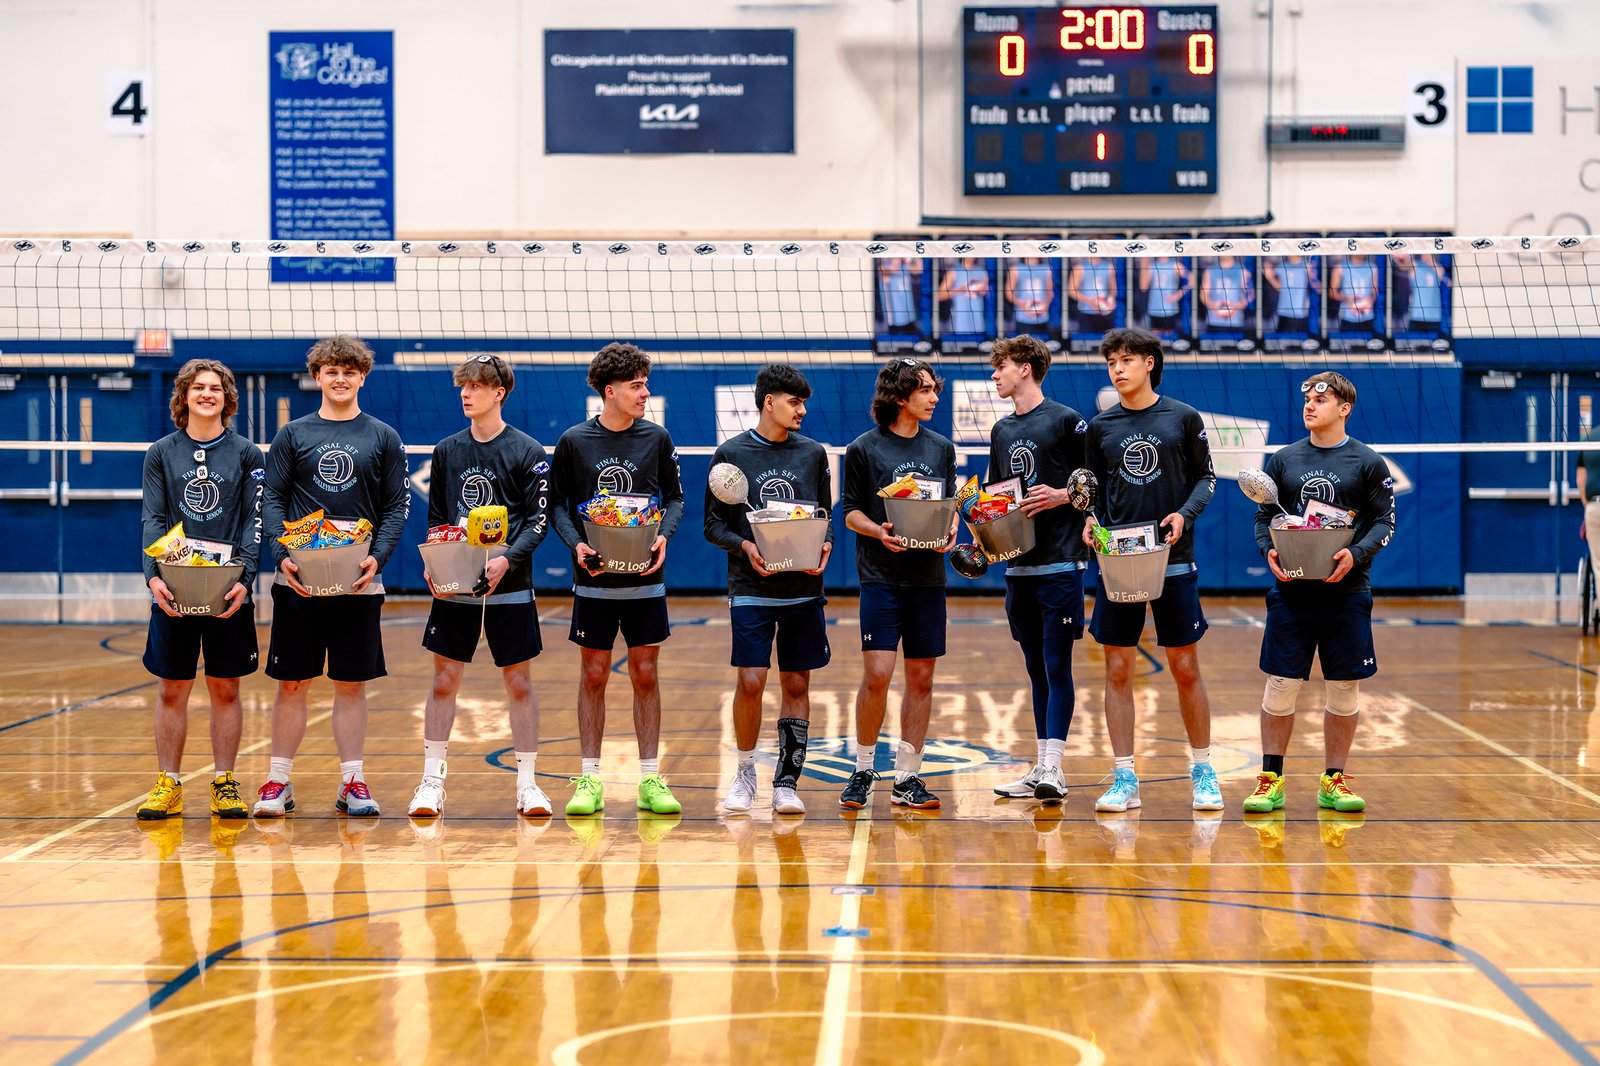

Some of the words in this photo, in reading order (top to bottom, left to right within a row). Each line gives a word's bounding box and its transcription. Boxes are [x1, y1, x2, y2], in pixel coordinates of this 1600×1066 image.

[974, 12, 1018, 32] Home
[1158, 10, 1212, 31] Guests
[1060, 9, 1145, 50] 2:00
[616, 55, 635, 66] and
[636, 55, 689, 66] Northwest
[691, 55, 728, 66] Indiana
[730, 55, 748, 66] Kia
[749, 55, 788, 66] Dealers
[999, 35, 1025, 76] 0
[1188, 33, 1214, 75] 0
[628, 71, 658, 82] Proud
[660, 72, 671, 82] to
[672, 72, 711, 84] support
[1066, 74, 1115, 97] period
[595, 84, 645, 96] Plainfield
[647, 84, 677, 96] South
[679, 84, 706, 97] High
[707, 84, 744, 96] School
[111, 80, 148, 125] 4
[1413, 81, 1448, 126] 3
[971, 106, 1008, 125] fouls
[1064, 103, 1116, 125] player
[1172, 104, 1210, 123] fouls
[974, 172, 1006, 188] won
[1070, 171, 1110, 190] game
[1176, 171, 1208, 187] won
[316, 442, 341, 454] FINAL
[343, 443, 359, 456] SET
[1008, 439, 1024, 455] FINAL
[1025, 439, 1038, 451] SET
[1120, 433, 1144, 449] FINAL
[1146, 434, 1162, 446] SET
[595, 456, 620, 470] FINAL
[623, 459, 639, 473] SET
[919, 462, 934, 475] SET
[209, 471, 225, 484] SET
[459, 466, 481, 481] FINAL
[483, 468, 497, 481] SET
[755, 468, 778, 485] FINAL
[781, 469, 797, 482] SET
[1300, 470, 1324, 482] FINAL
[1327, 472, 1341, 485] SET
[313, 474, 339, 493] VOLLEYBALL
[533, 479, 549, 534] 2025
[999, 546, 1022, 562] Alex
[607, 558, 625, 571] #12
[316, 583, 343, 596] Jack
[1109, 591, 1120, 600] #7
[1122, 590, 1149, 602] Emilio
[180, 604, 211, 614] Lucas
